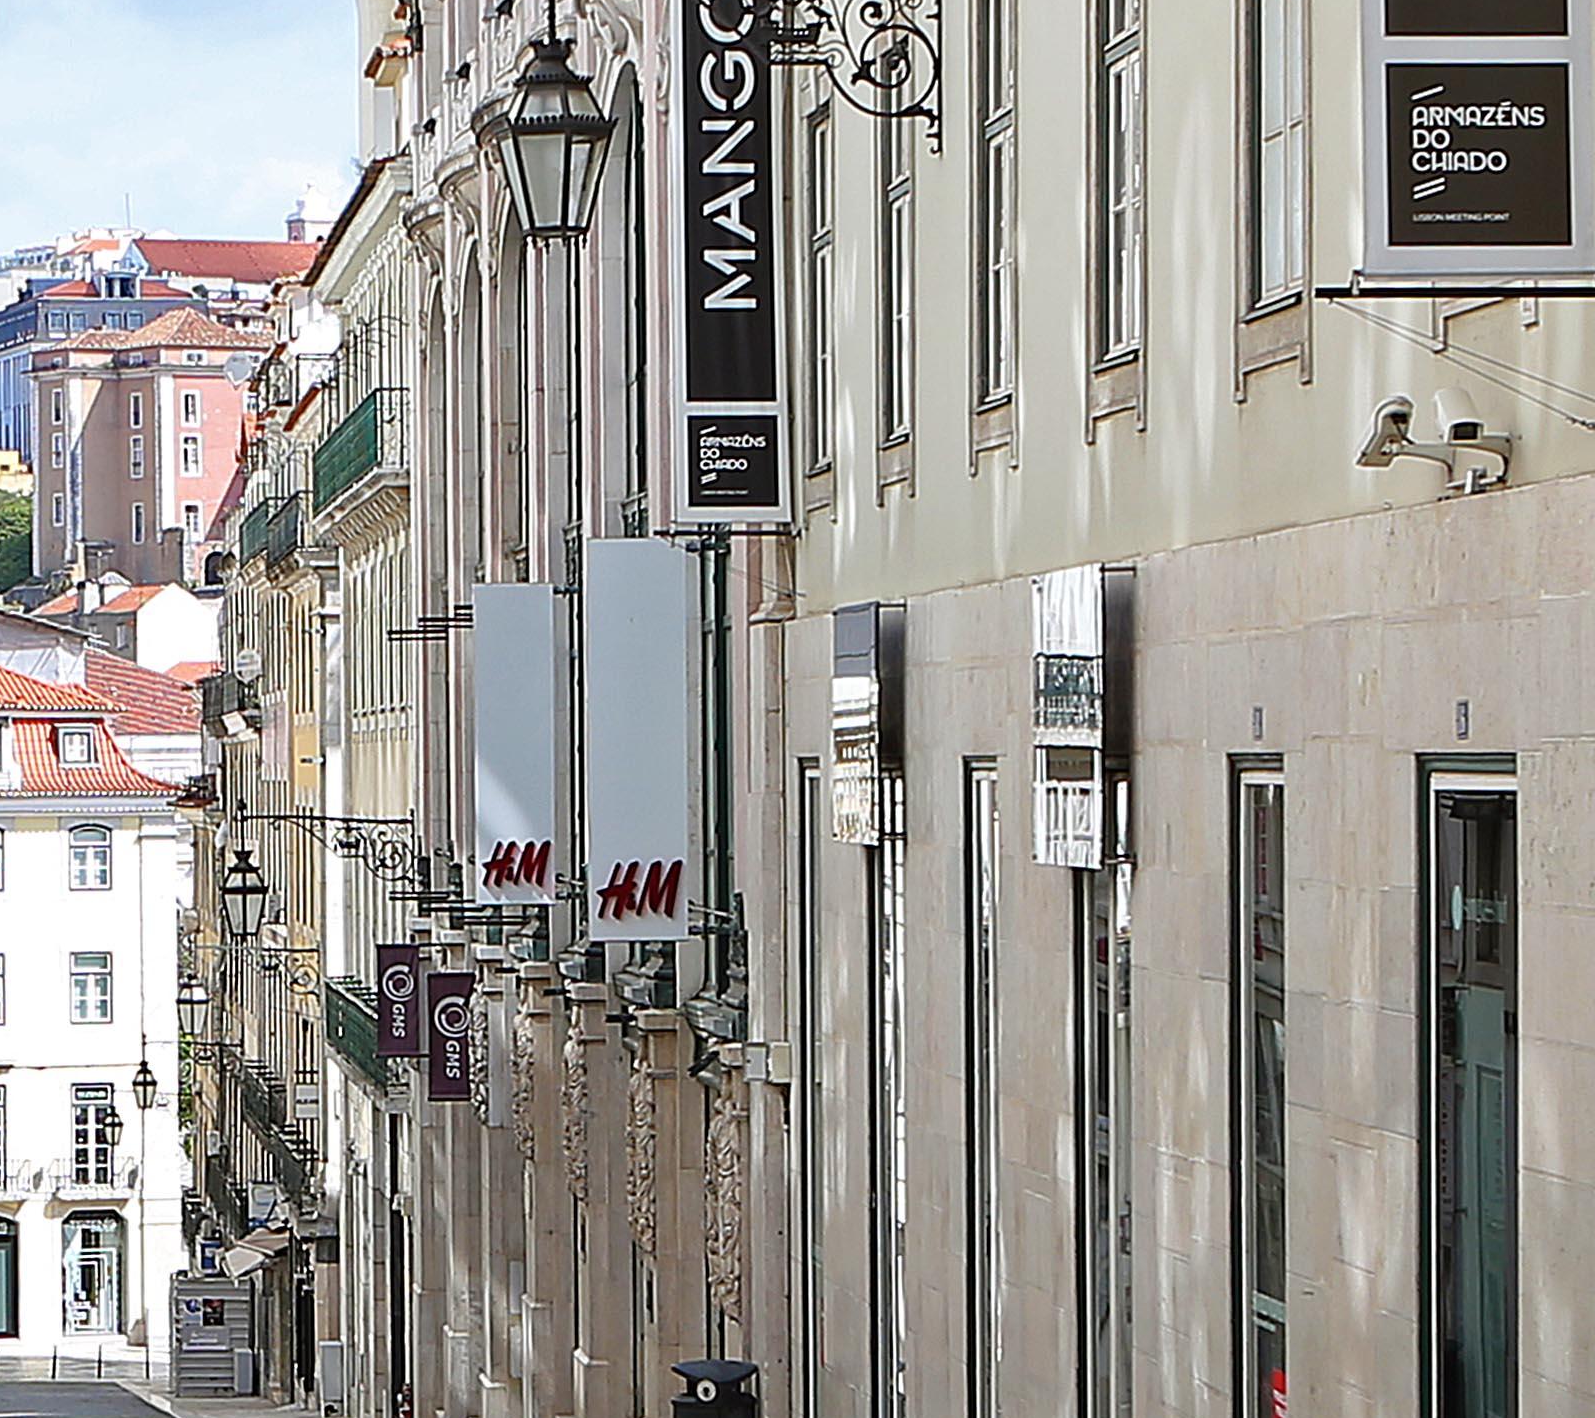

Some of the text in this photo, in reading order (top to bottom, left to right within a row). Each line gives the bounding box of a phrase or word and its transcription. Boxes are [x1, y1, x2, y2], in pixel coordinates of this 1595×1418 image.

[1412, 101, 1545, 126] ARMAZÉNS
[1412, 129, 1450, 149] DO
[1412, 151, 1507, 171] CHIADO
[1445, 213, 1482, 221] MEETING
[1484, 213, 1510, 221] POINT
[700, 448, 720, 458] DO
[700, 459, 747, 470] CHIADO
[482, 839, 552, 888] H&M
[595, 858, 684, 920] H&M
[391, 1003, 406, 1039] GMS
[444, 1039, 461, 1080] GMS
